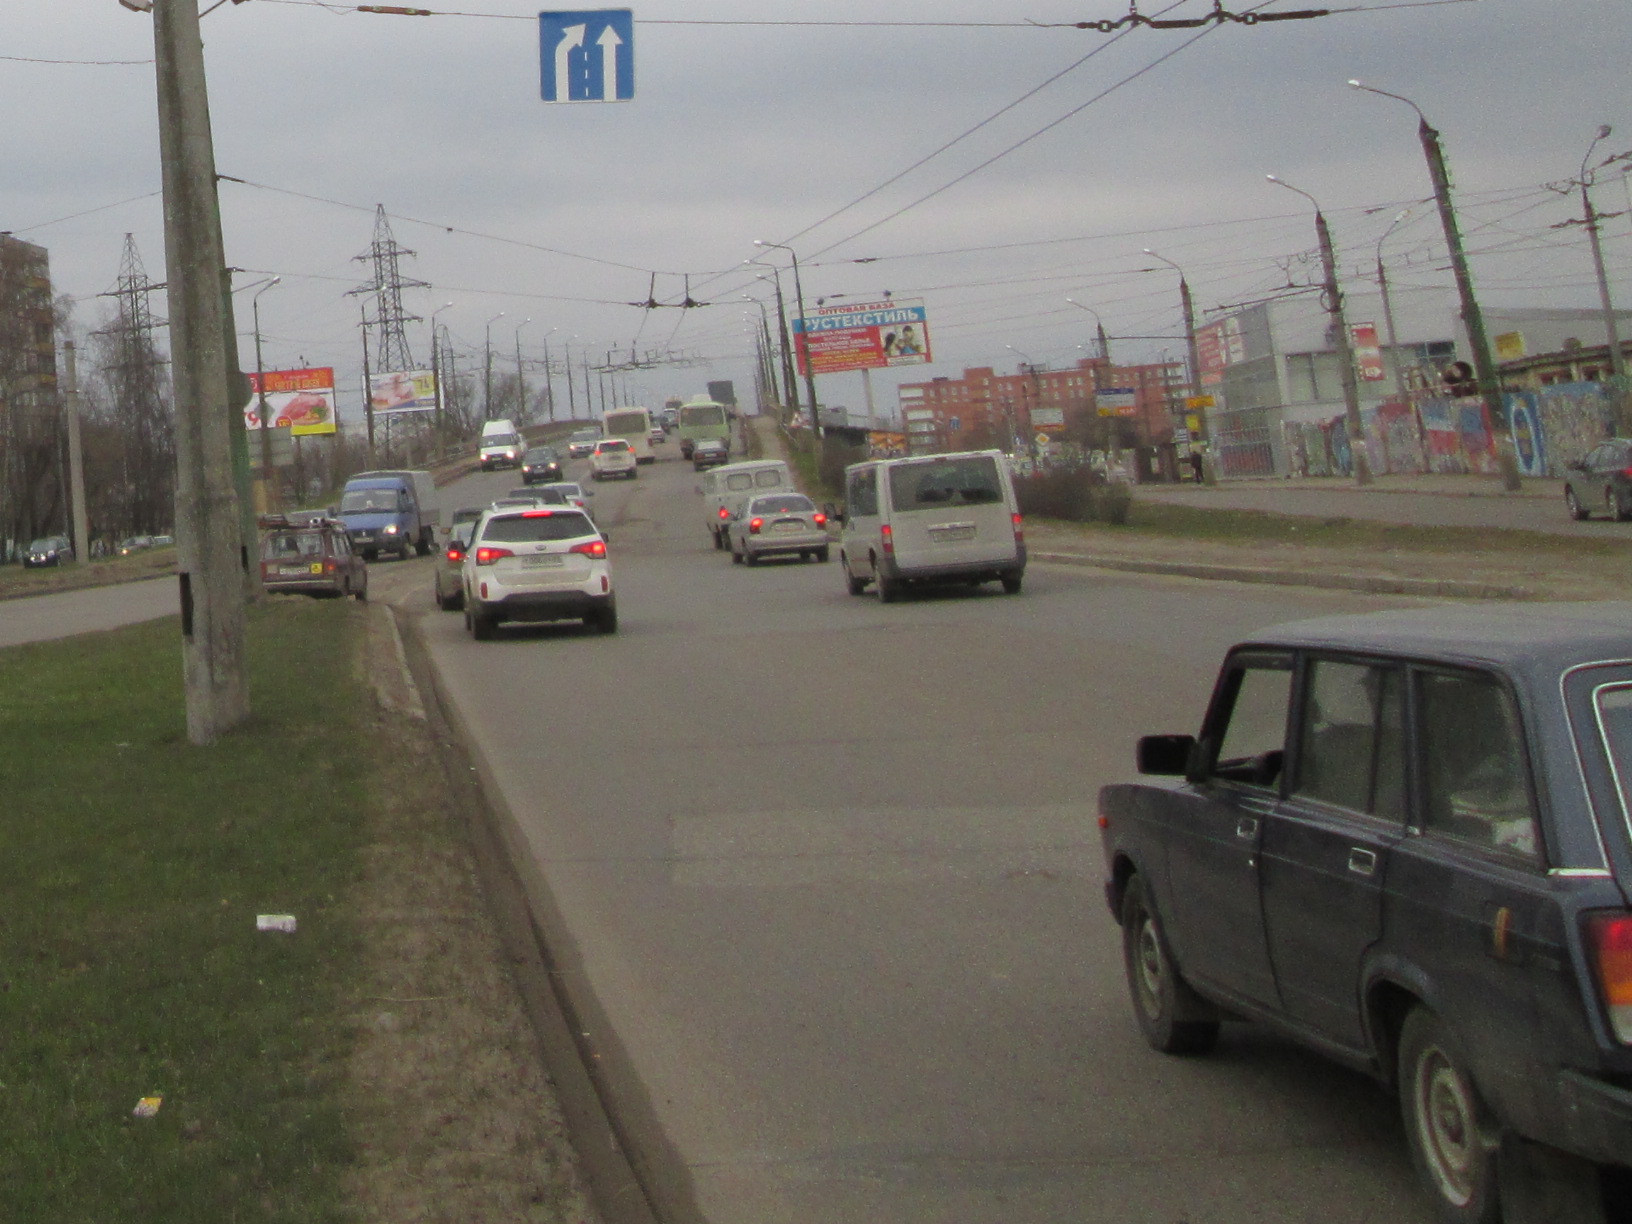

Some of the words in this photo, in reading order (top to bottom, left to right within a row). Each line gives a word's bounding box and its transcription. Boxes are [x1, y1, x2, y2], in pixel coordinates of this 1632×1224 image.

[818, 304, 866, 315] ОПТОВАЯ
[869, 302, 896, 311] БАЗА
[803, 309, 919, 330] РУСТЕКСТИЛЬ
